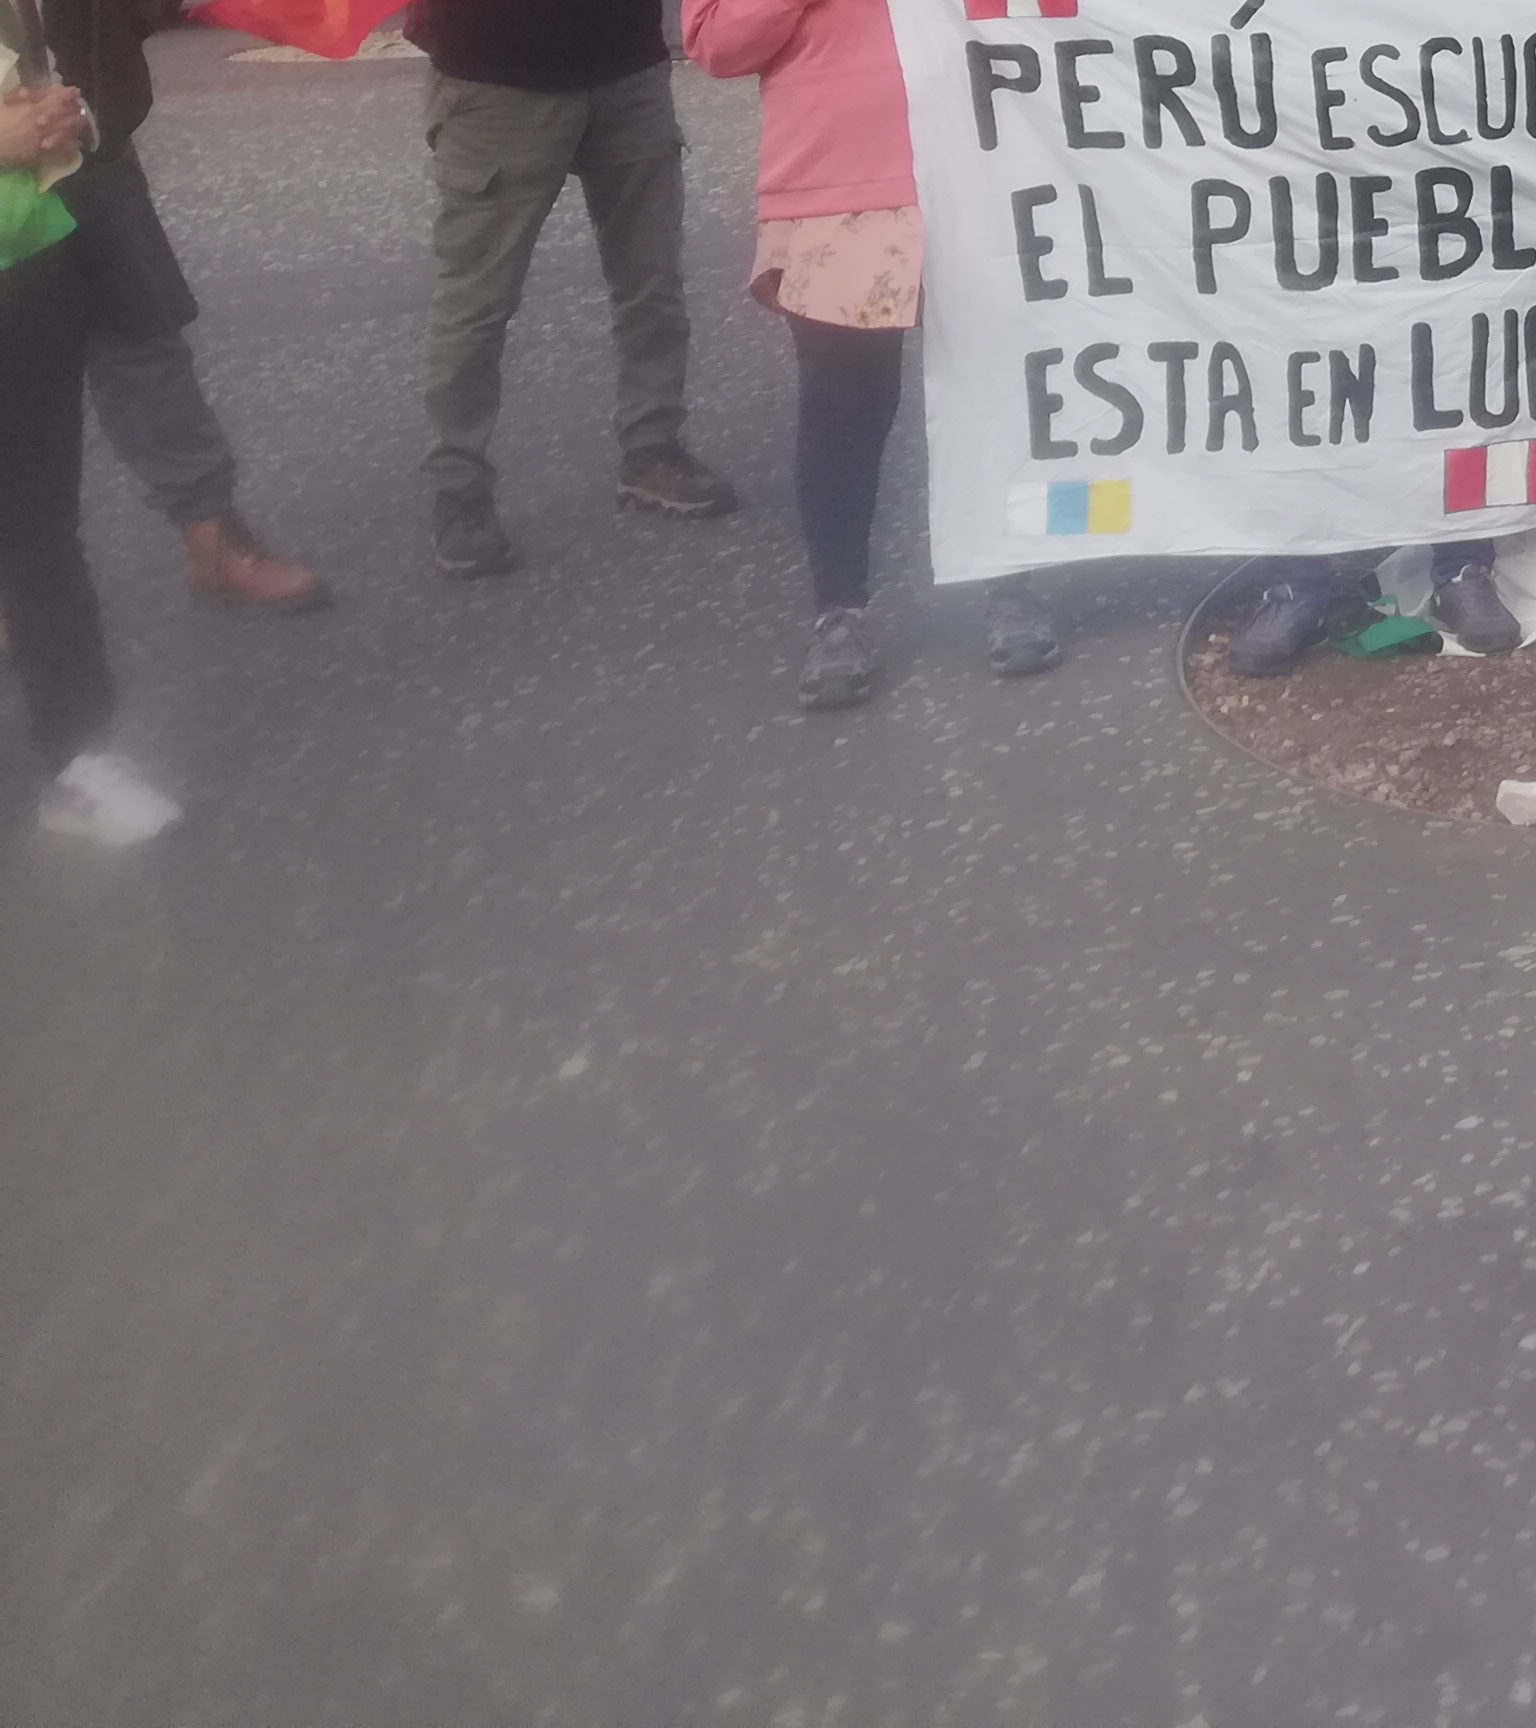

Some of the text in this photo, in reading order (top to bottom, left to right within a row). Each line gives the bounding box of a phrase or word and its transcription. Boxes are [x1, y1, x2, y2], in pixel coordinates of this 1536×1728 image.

[1010, 183, 1133, 303] EL
[1024, 341, 1260, 461] ESTA
[1287, 343, 1377, 447] EN
